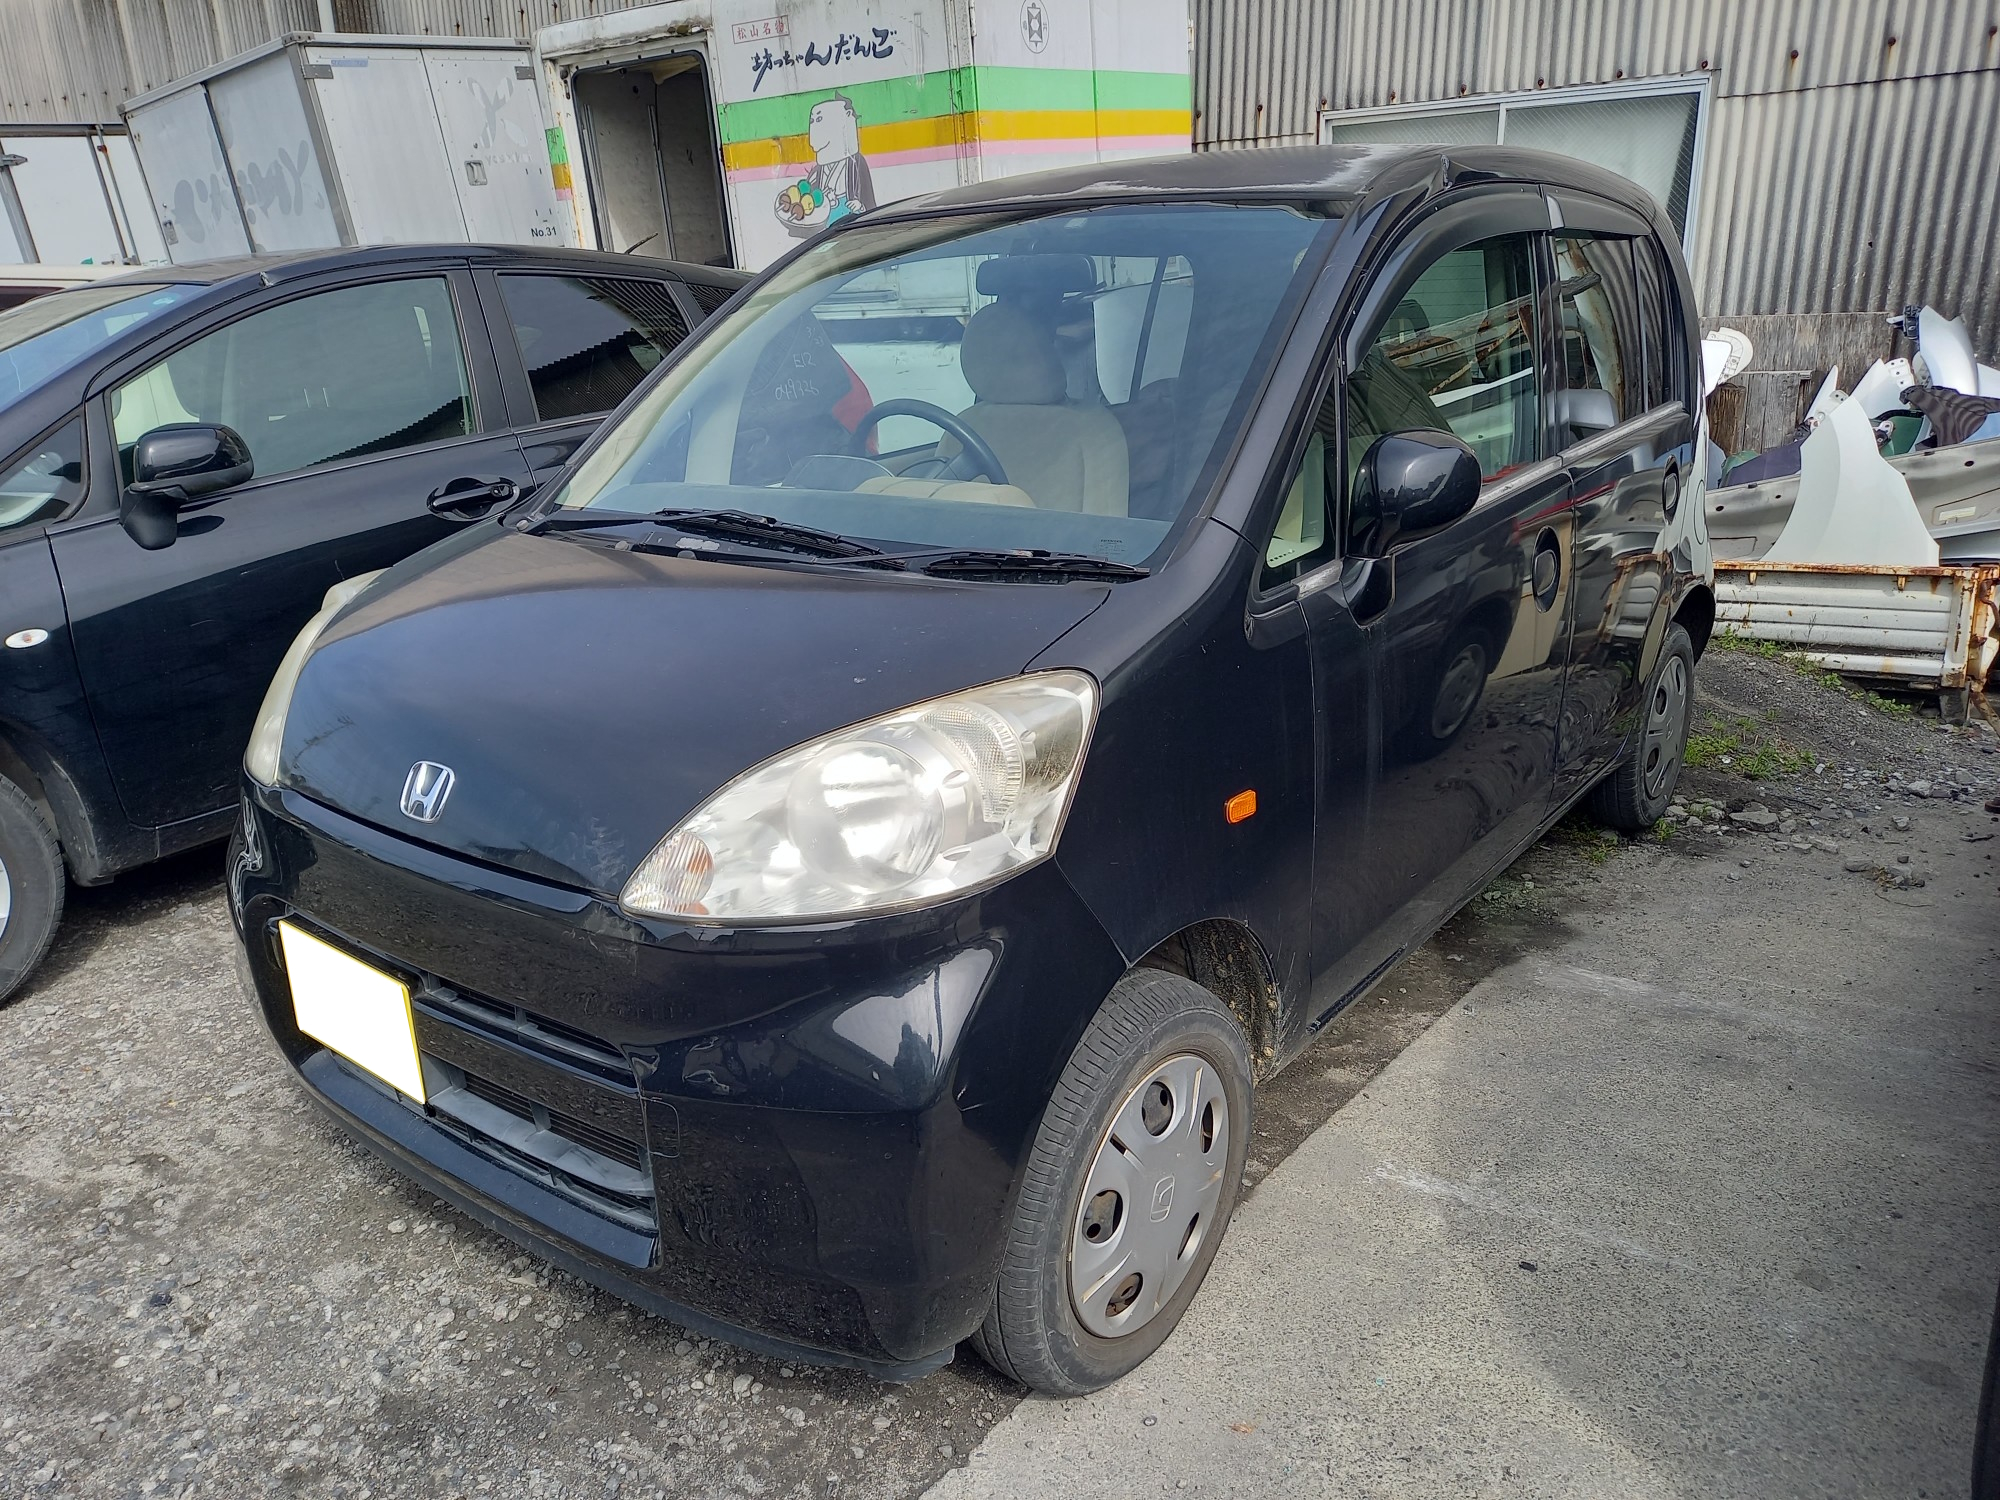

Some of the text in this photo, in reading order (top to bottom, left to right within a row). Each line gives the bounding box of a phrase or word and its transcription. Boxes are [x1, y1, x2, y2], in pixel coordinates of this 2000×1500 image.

[737, 19, 785, 40] 松山名物
[751, 28, 897, 92] 坊っちゃんだんご
[531, 226, 557, 238] No.31
